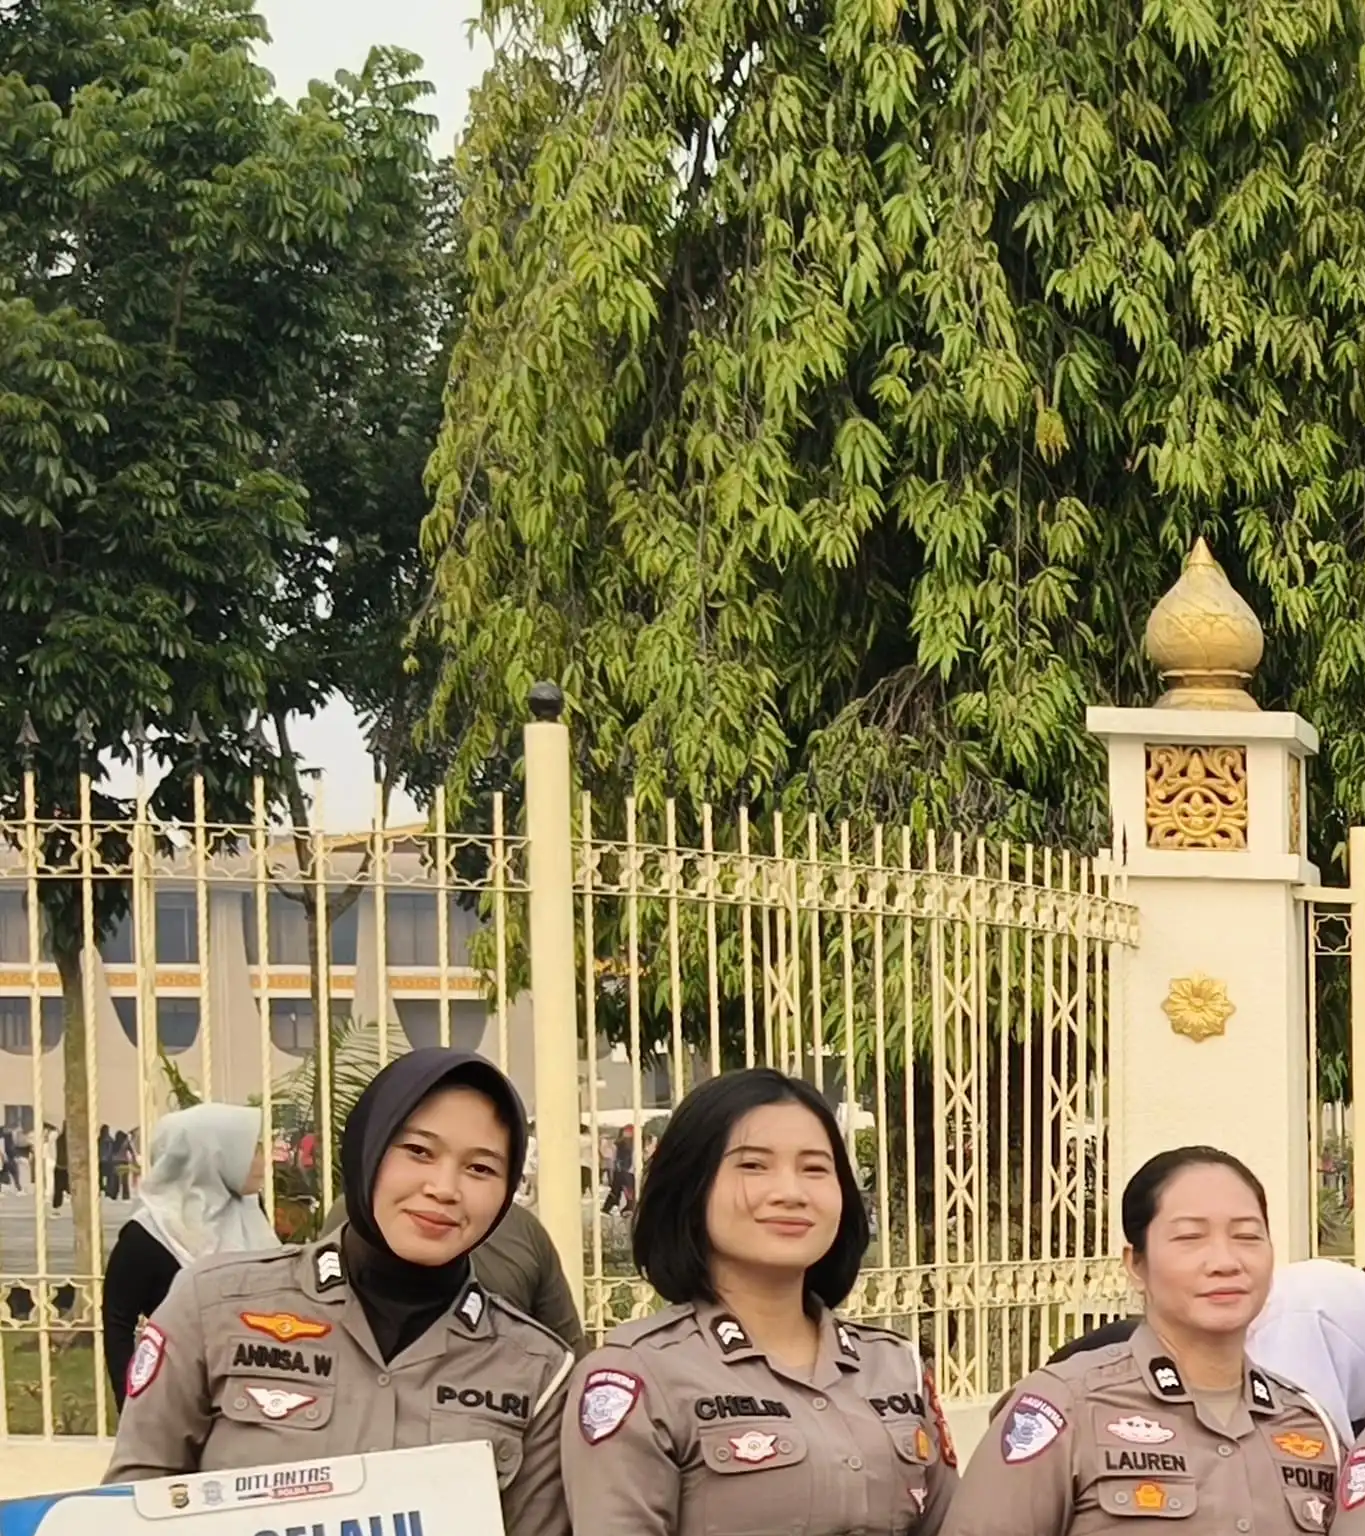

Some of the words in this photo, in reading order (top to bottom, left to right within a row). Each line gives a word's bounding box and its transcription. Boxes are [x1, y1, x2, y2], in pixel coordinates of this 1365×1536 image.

[313, 1355, 332, 1377] W
[436, 1385, 530, 1419] POLRI
[1105, 1450, 1186, 1472] LAUREN
[1282, 1464, 1334, 1494] POLRI
